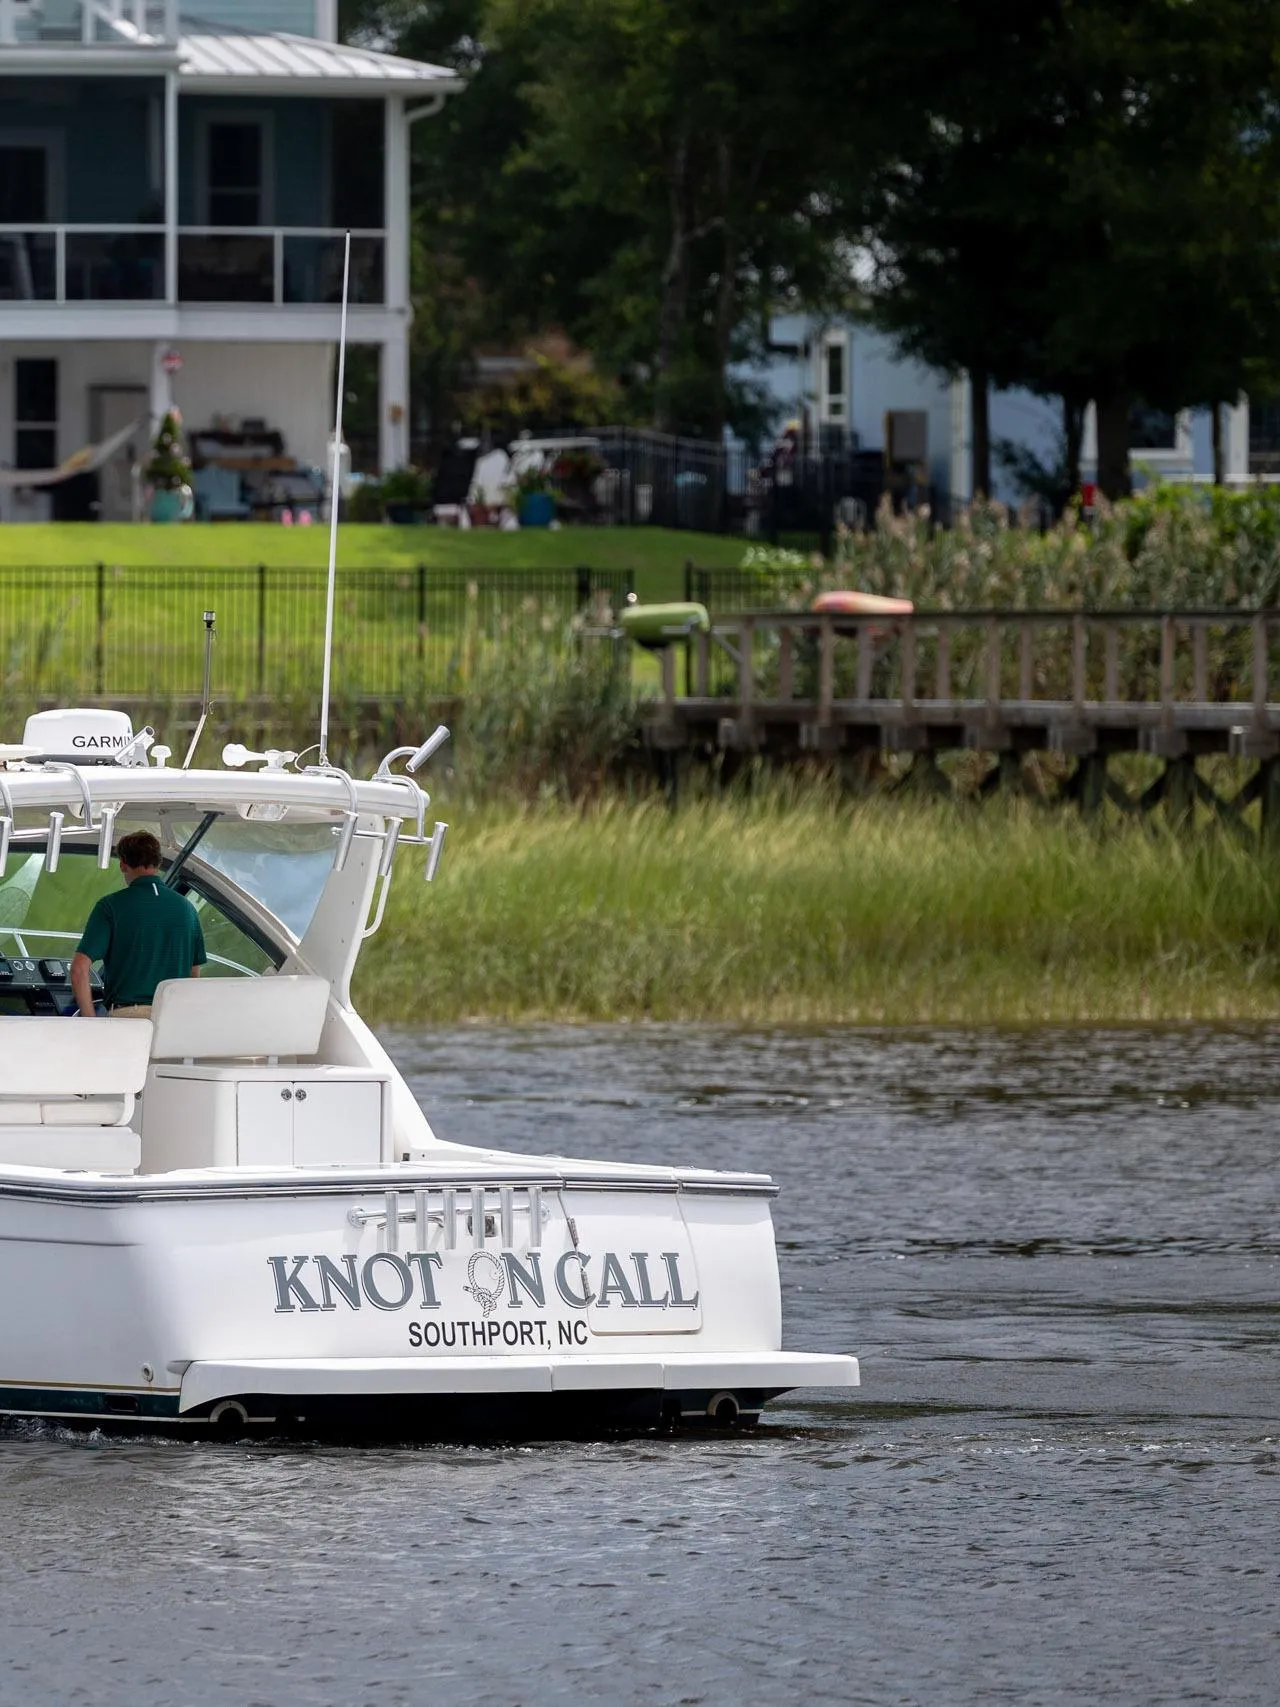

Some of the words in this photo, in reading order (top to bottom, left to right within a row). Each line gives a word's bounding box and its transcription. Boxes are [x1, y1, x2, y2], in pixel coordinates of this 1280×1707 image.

[267, 1251, 443, 1313] KNOT
[554, 1250, 699, 1311] CALL
[408, 1320, 552, 1349] SOUTHPORT,
[558, 1319, 589, 1346] NC
